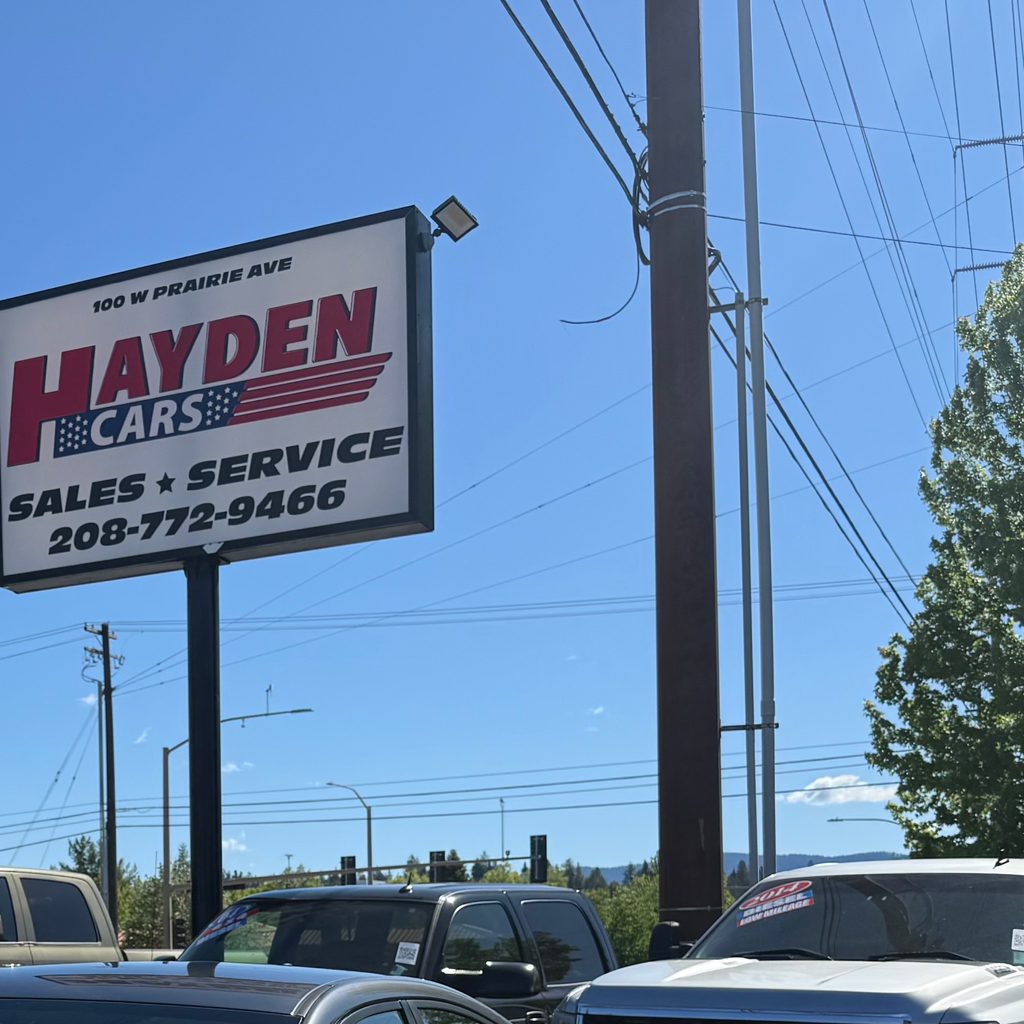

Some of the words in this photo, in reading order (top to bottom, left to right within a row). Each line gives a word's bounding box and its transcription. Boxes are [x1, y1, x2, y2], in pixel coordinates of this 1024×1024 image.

[92, 294, 126, 314] 100
[130, 289, 150, 305] W
[152, 268, 243, 301] PRAIRIE
[247, 256, 293, 280] AVE
[6, 286, 378, 467] HAYDEN
[90, 392, 204, 447] CARS
[8, 472, 146, 522] SALES
[186, 425, 405, 491] SERVICE
[48, 479, 347, 555] 208-772-9466
